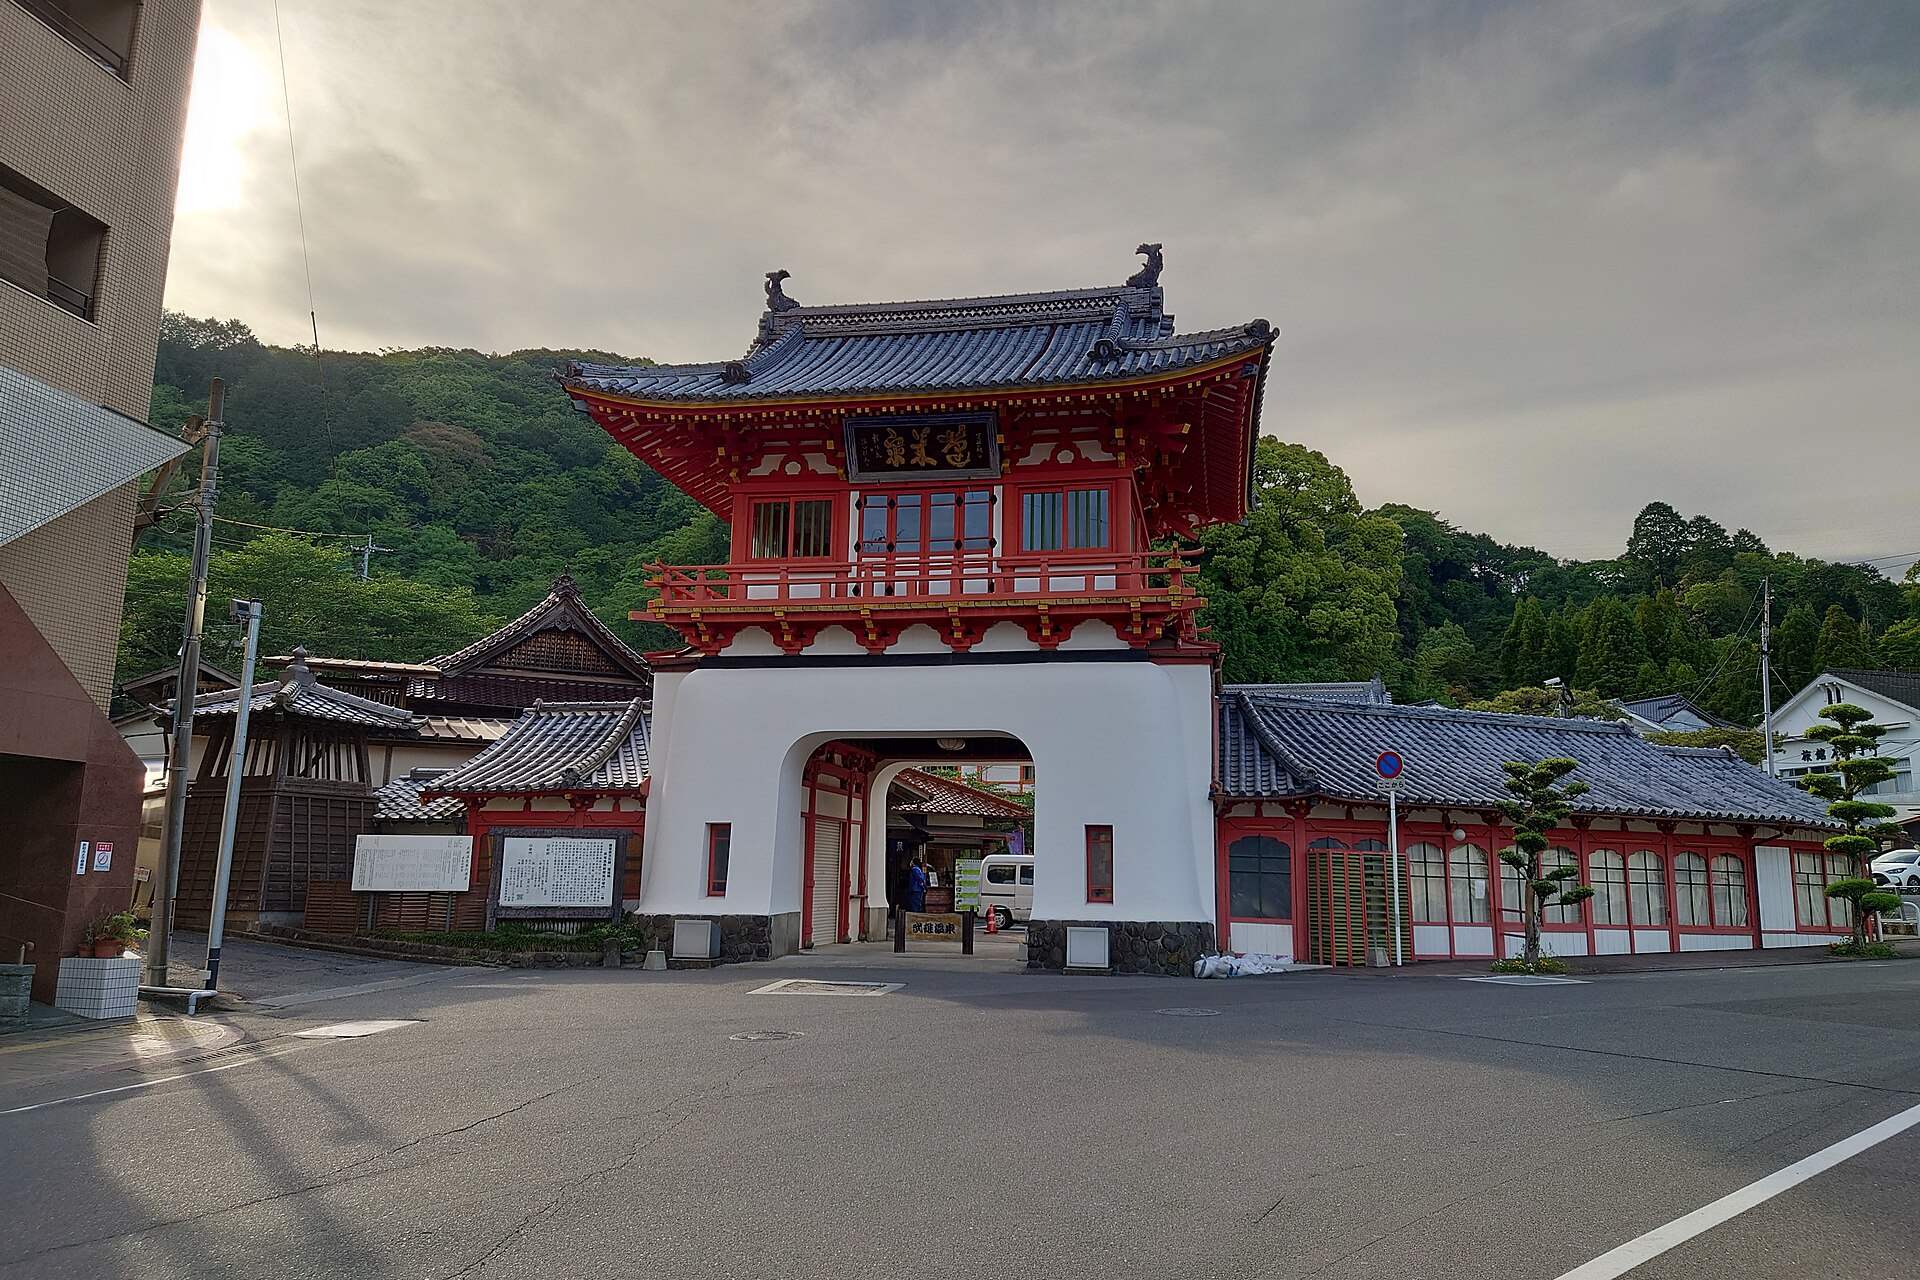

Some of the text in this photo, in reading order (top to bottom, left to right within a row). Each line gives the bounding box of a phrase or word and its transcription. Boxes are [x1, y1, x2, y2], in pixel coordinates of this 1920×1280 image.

[1378, 781, 1404, 789] ここから
[912, 922, 956, 934] 武雄温泉
